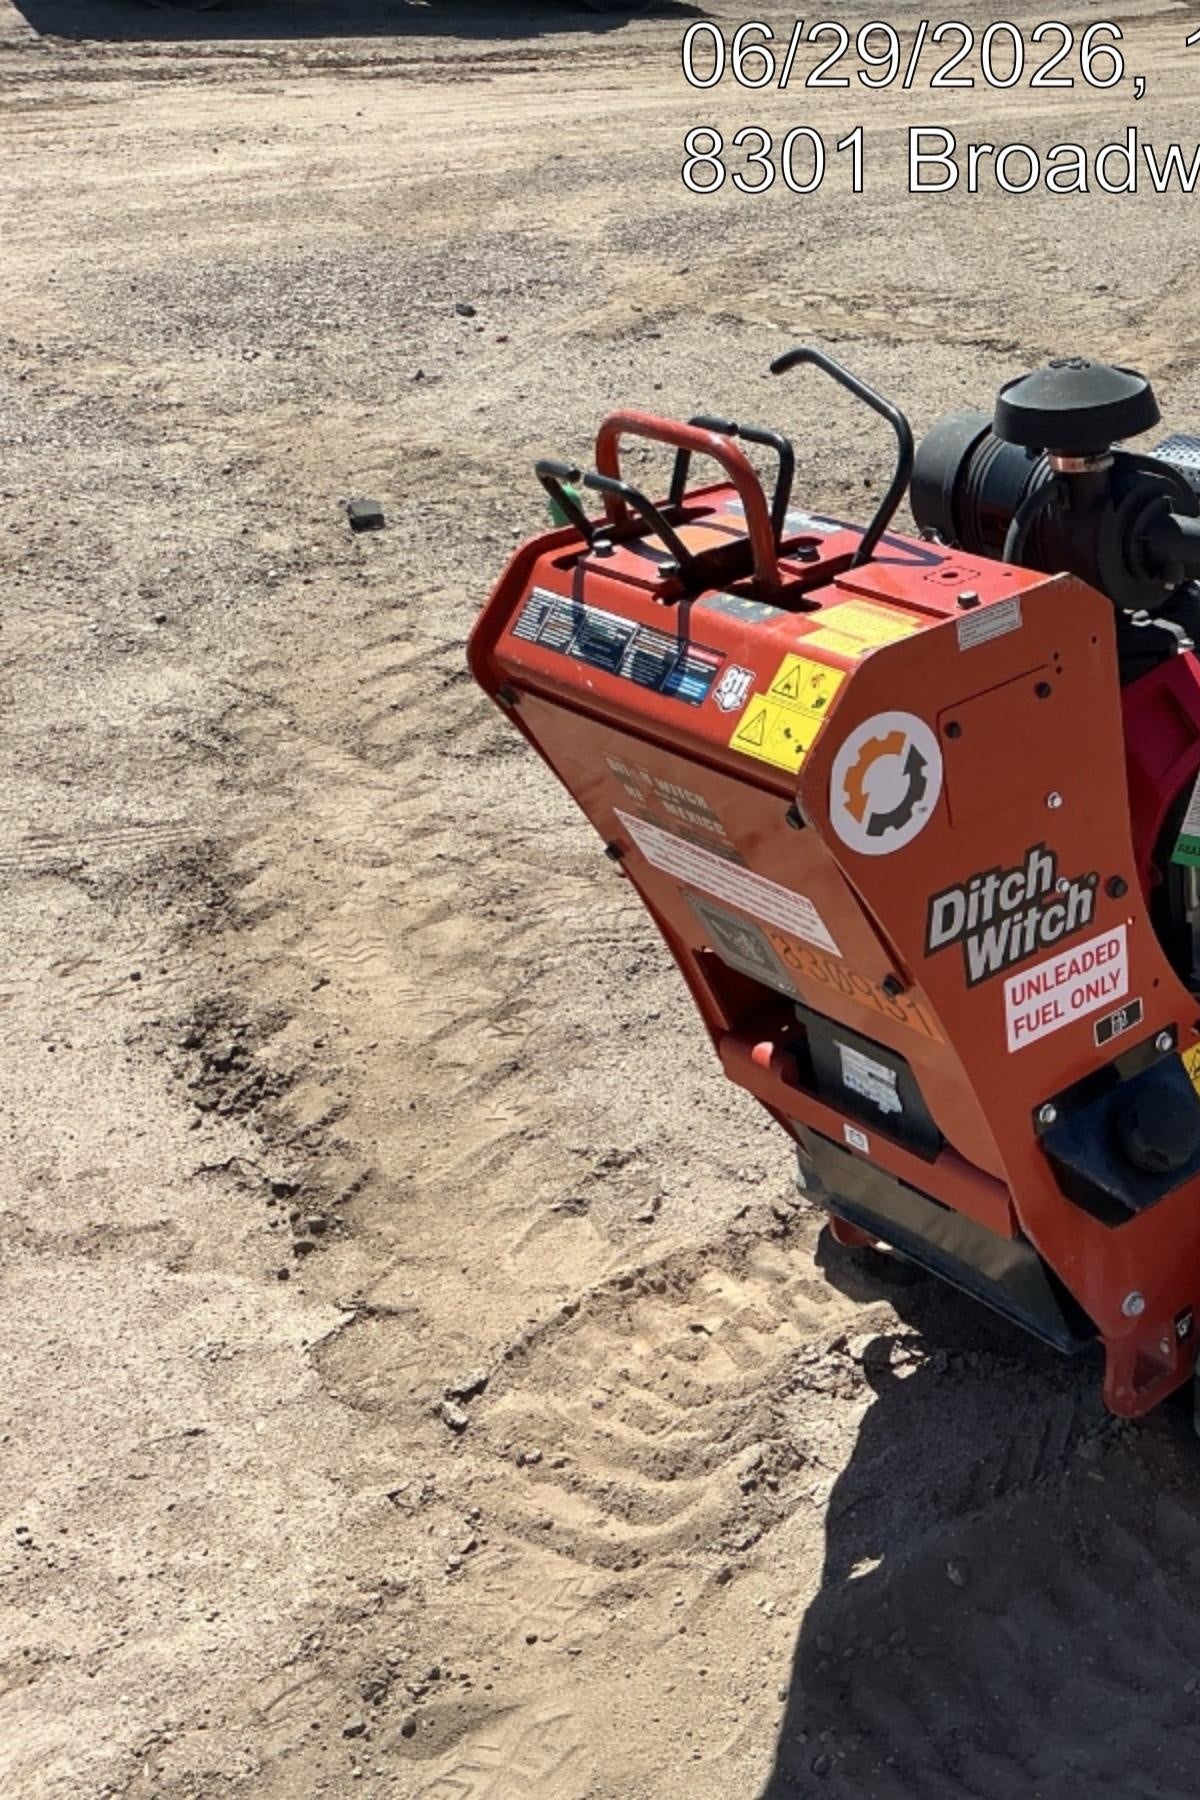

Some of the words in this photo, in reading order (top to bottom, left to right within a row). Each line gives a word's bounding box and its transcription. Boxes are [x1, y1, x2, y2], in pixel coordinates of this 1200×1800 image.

[720, 667, 754, 699] 811
[927, 846, 1055, 952] Ditch
[965, 878, 1096, 985] Witch
[1011, 939, 1121, 1006] UNLEADED
[1013, 1001, 1065, 1040] FUEL
[1071, 967, 1121, 1010] ONLY
